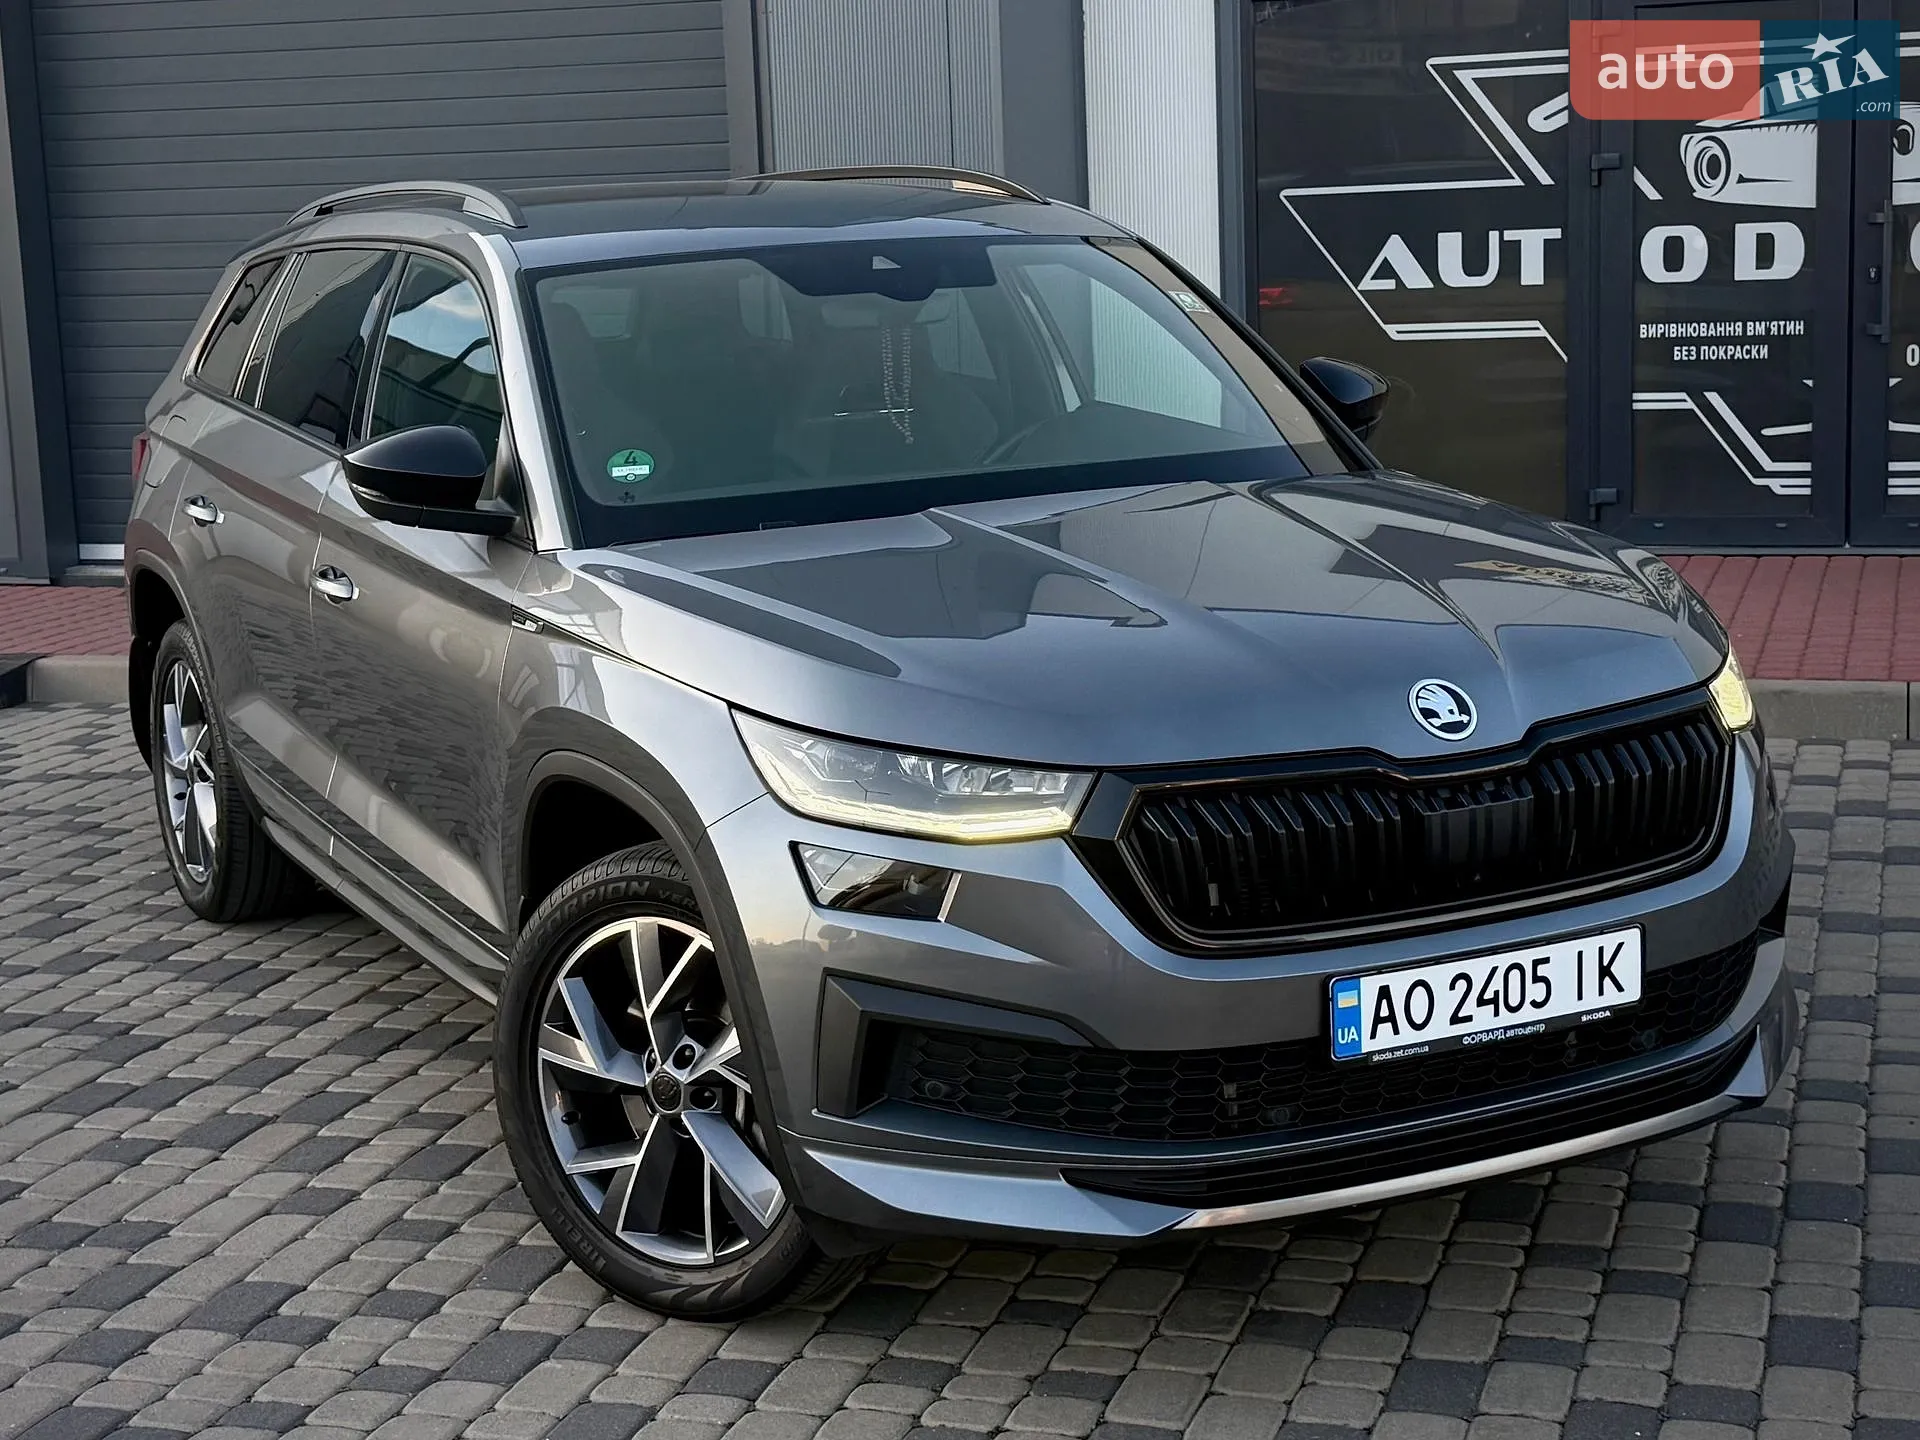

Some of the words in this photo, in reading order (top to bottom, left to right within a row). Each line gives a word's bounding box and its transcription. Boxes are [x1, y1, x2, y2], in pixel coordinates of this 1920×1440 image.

[1639, 322, 1743, 339] ВИРІВНЮВАННЯ
[1746, 320, 1804, 336] ВМ'ЯТИН
[1673, 346, 1697, 361] БЕЗ
[1700, 344, 1769, 360] ПОКРАСКИ
[624, 451, 638, 466] 4
[1369, 978, 1435, 1040] AO
[1448, 956, 1552, 1026] 2405
[1576, 941, 1625, 1002] IK
[1337, 1027, 1359, 1044] UA
[1462, 1026, 1505, 1045] ФОРВАРД
[1505, 1023, 1546, 1038] автоцентр
